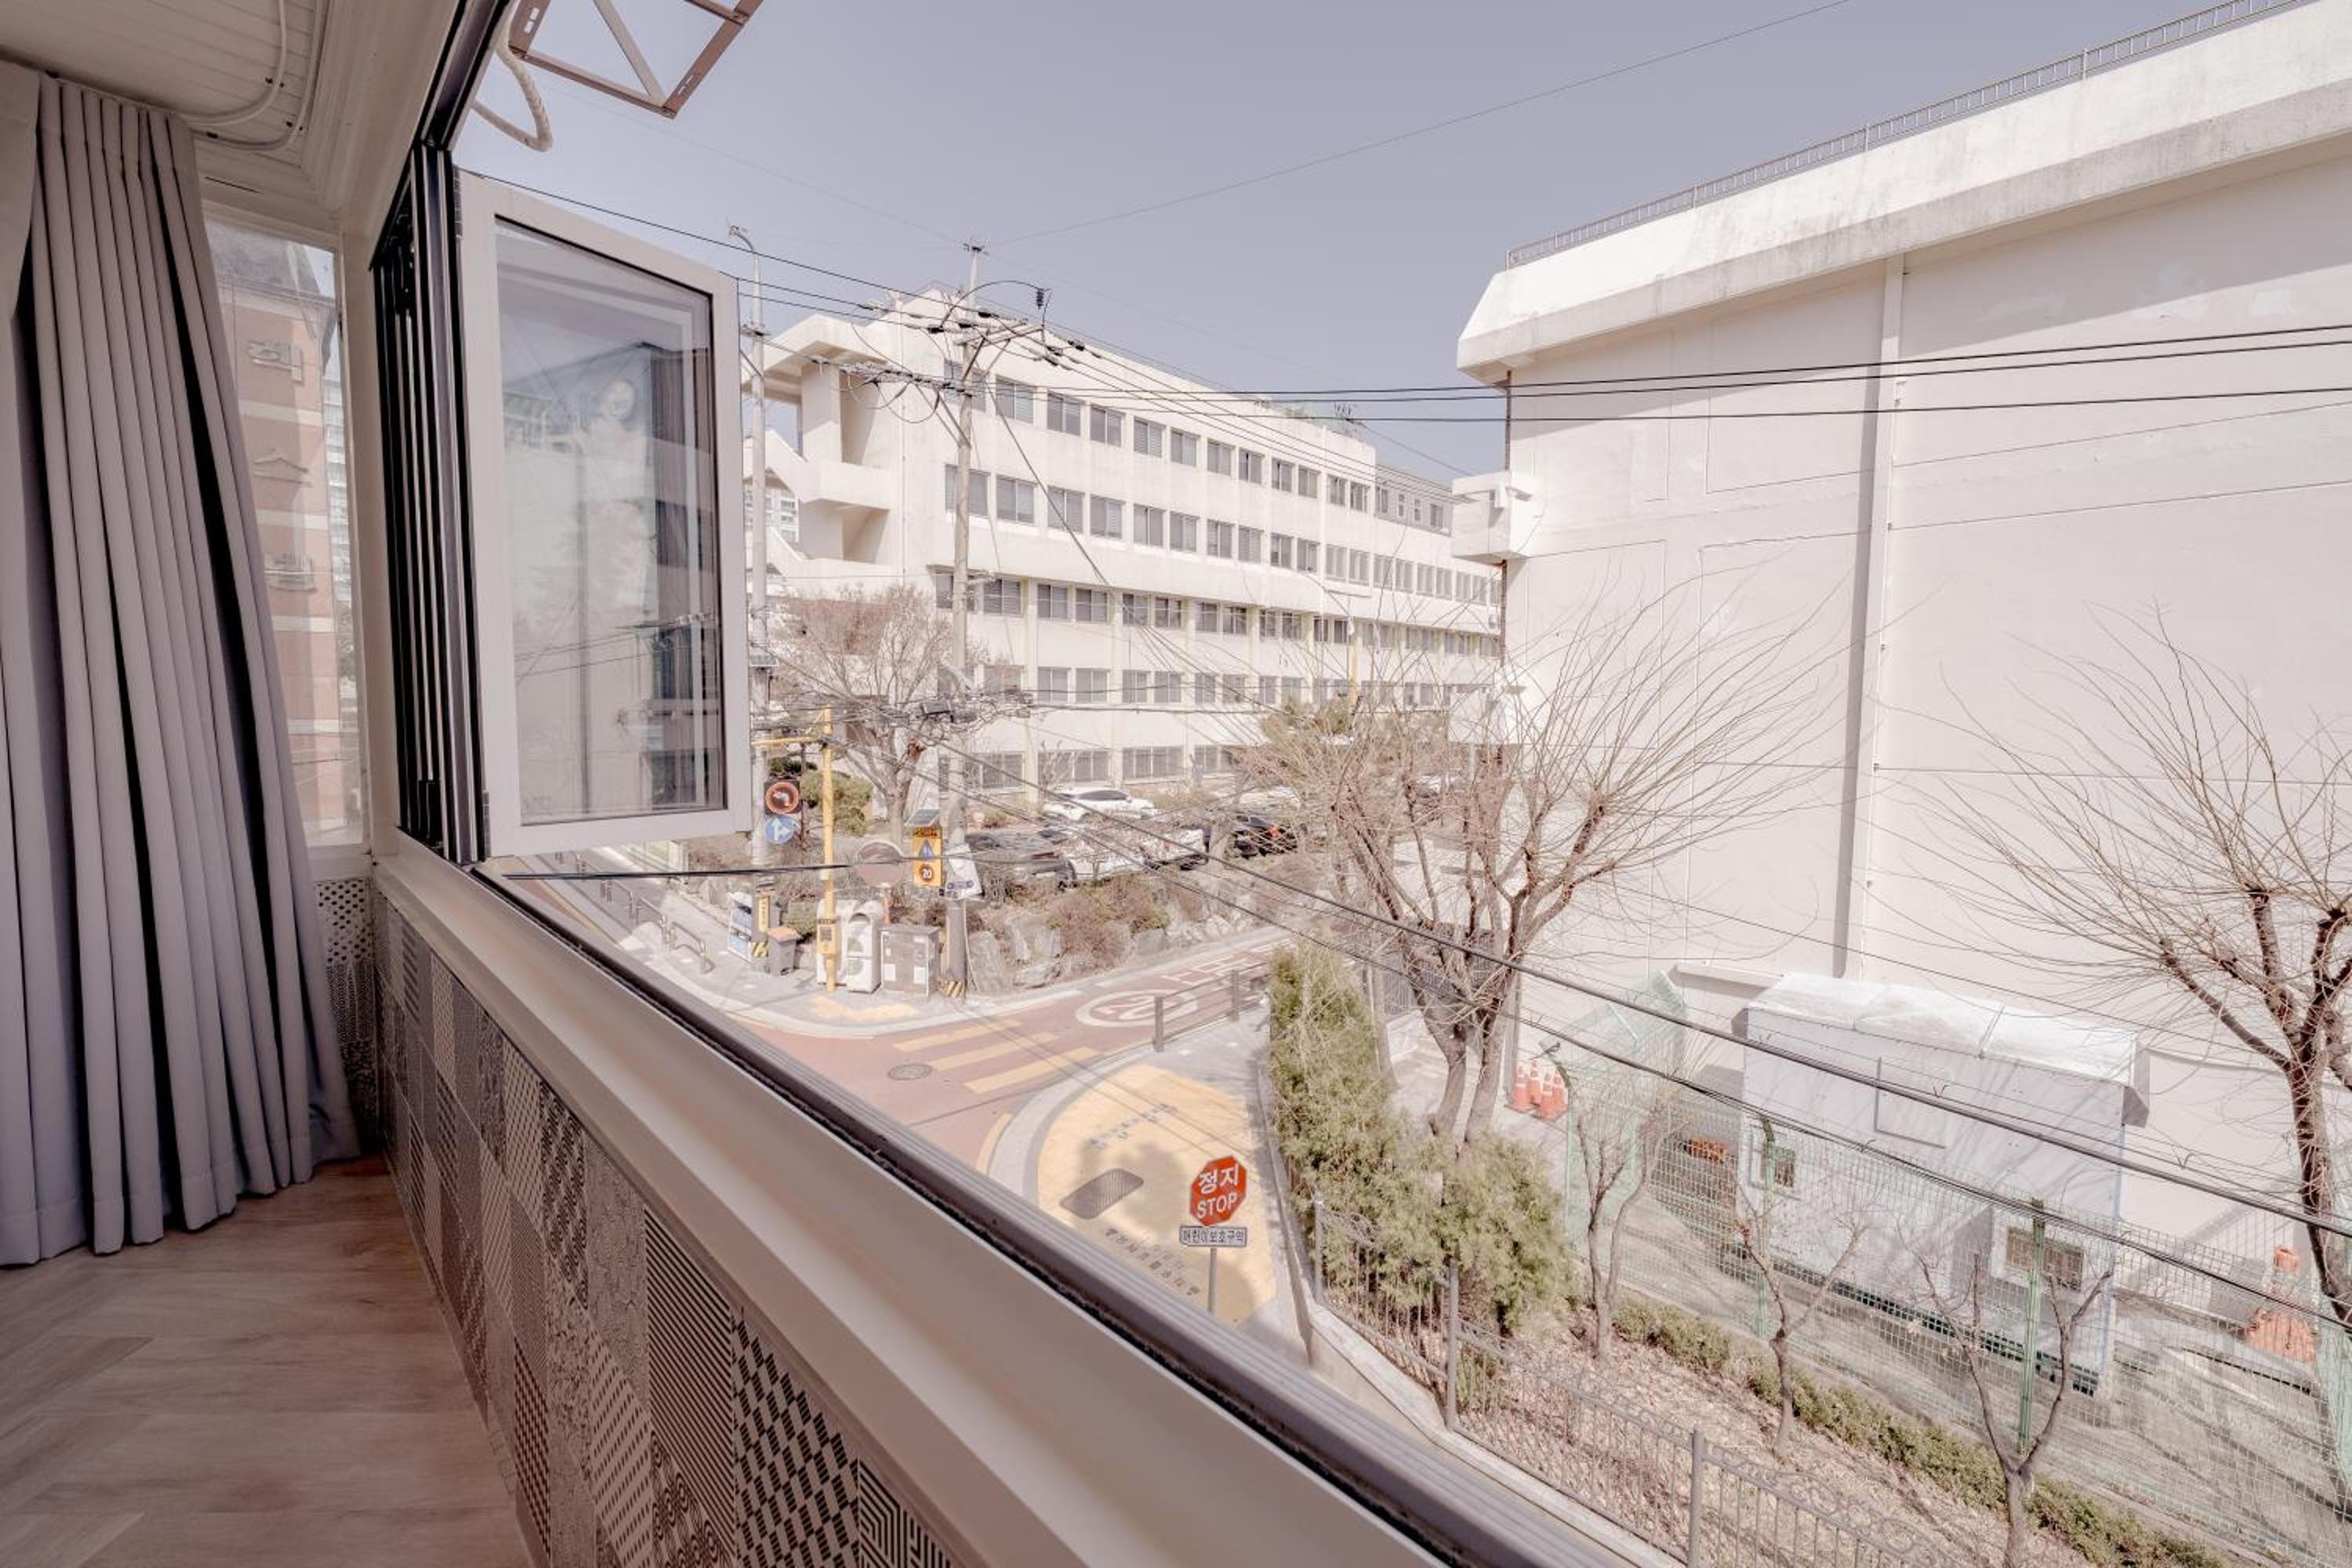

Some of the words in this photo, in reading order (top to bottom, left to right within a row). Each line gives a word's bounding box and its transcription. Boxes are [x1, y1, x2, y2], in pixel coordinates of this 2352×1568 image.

[1199, 1163, 1239, 1194] 정지
[1197, 1192, 1237, 1218] STOP
[1183, 1229, 1243, 1243] 어린이보호구역
